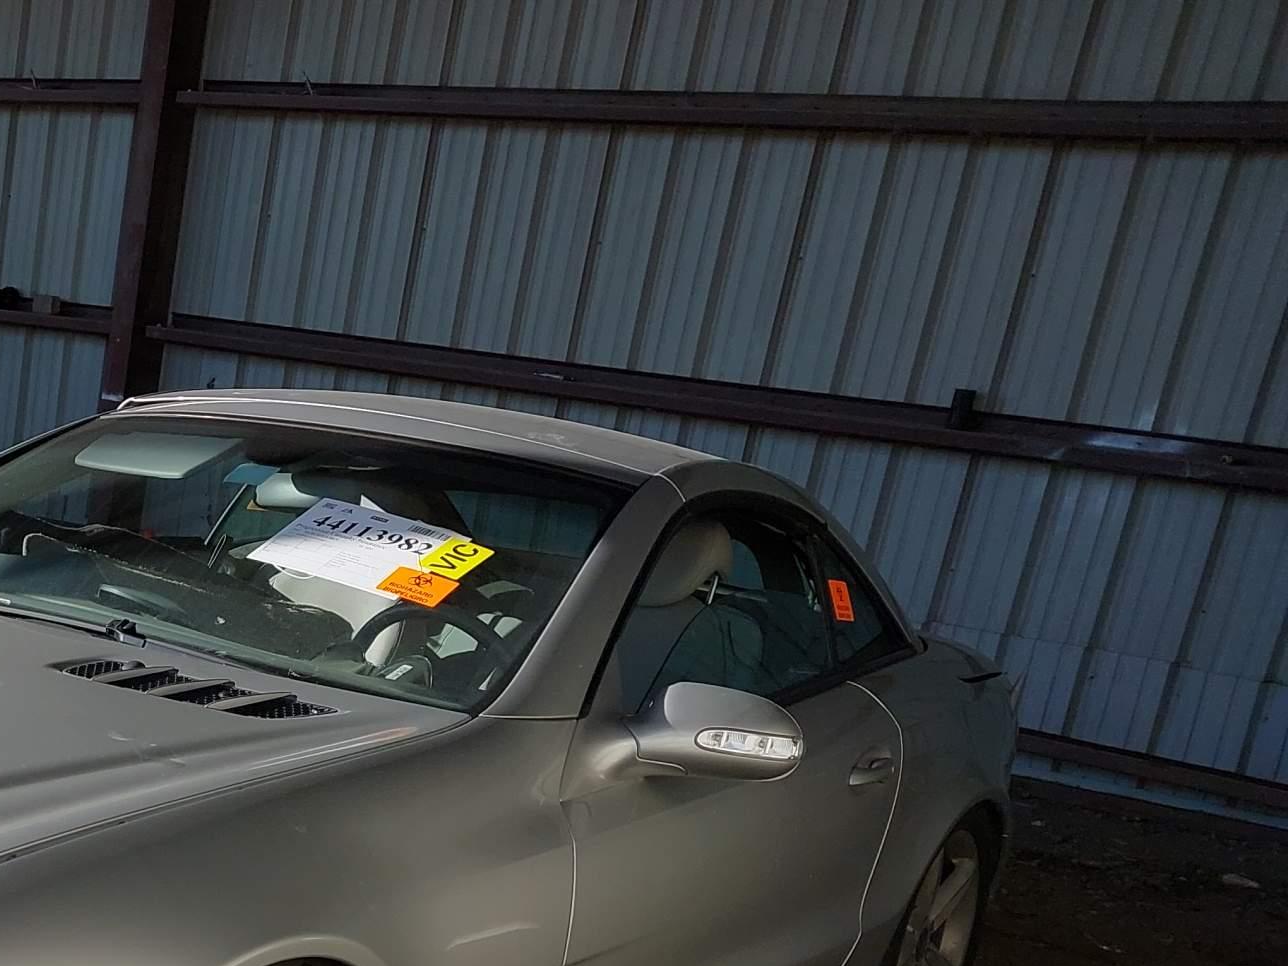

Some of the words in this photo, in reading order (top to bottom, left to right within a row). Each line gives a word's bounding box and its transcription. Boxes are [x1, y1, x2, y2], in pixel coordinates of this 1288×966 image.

[312, 515, 433, 555] 44113982
[428, 543, 480, 570] VIC
[388, 582, 434, 599] BIOHAZARD
